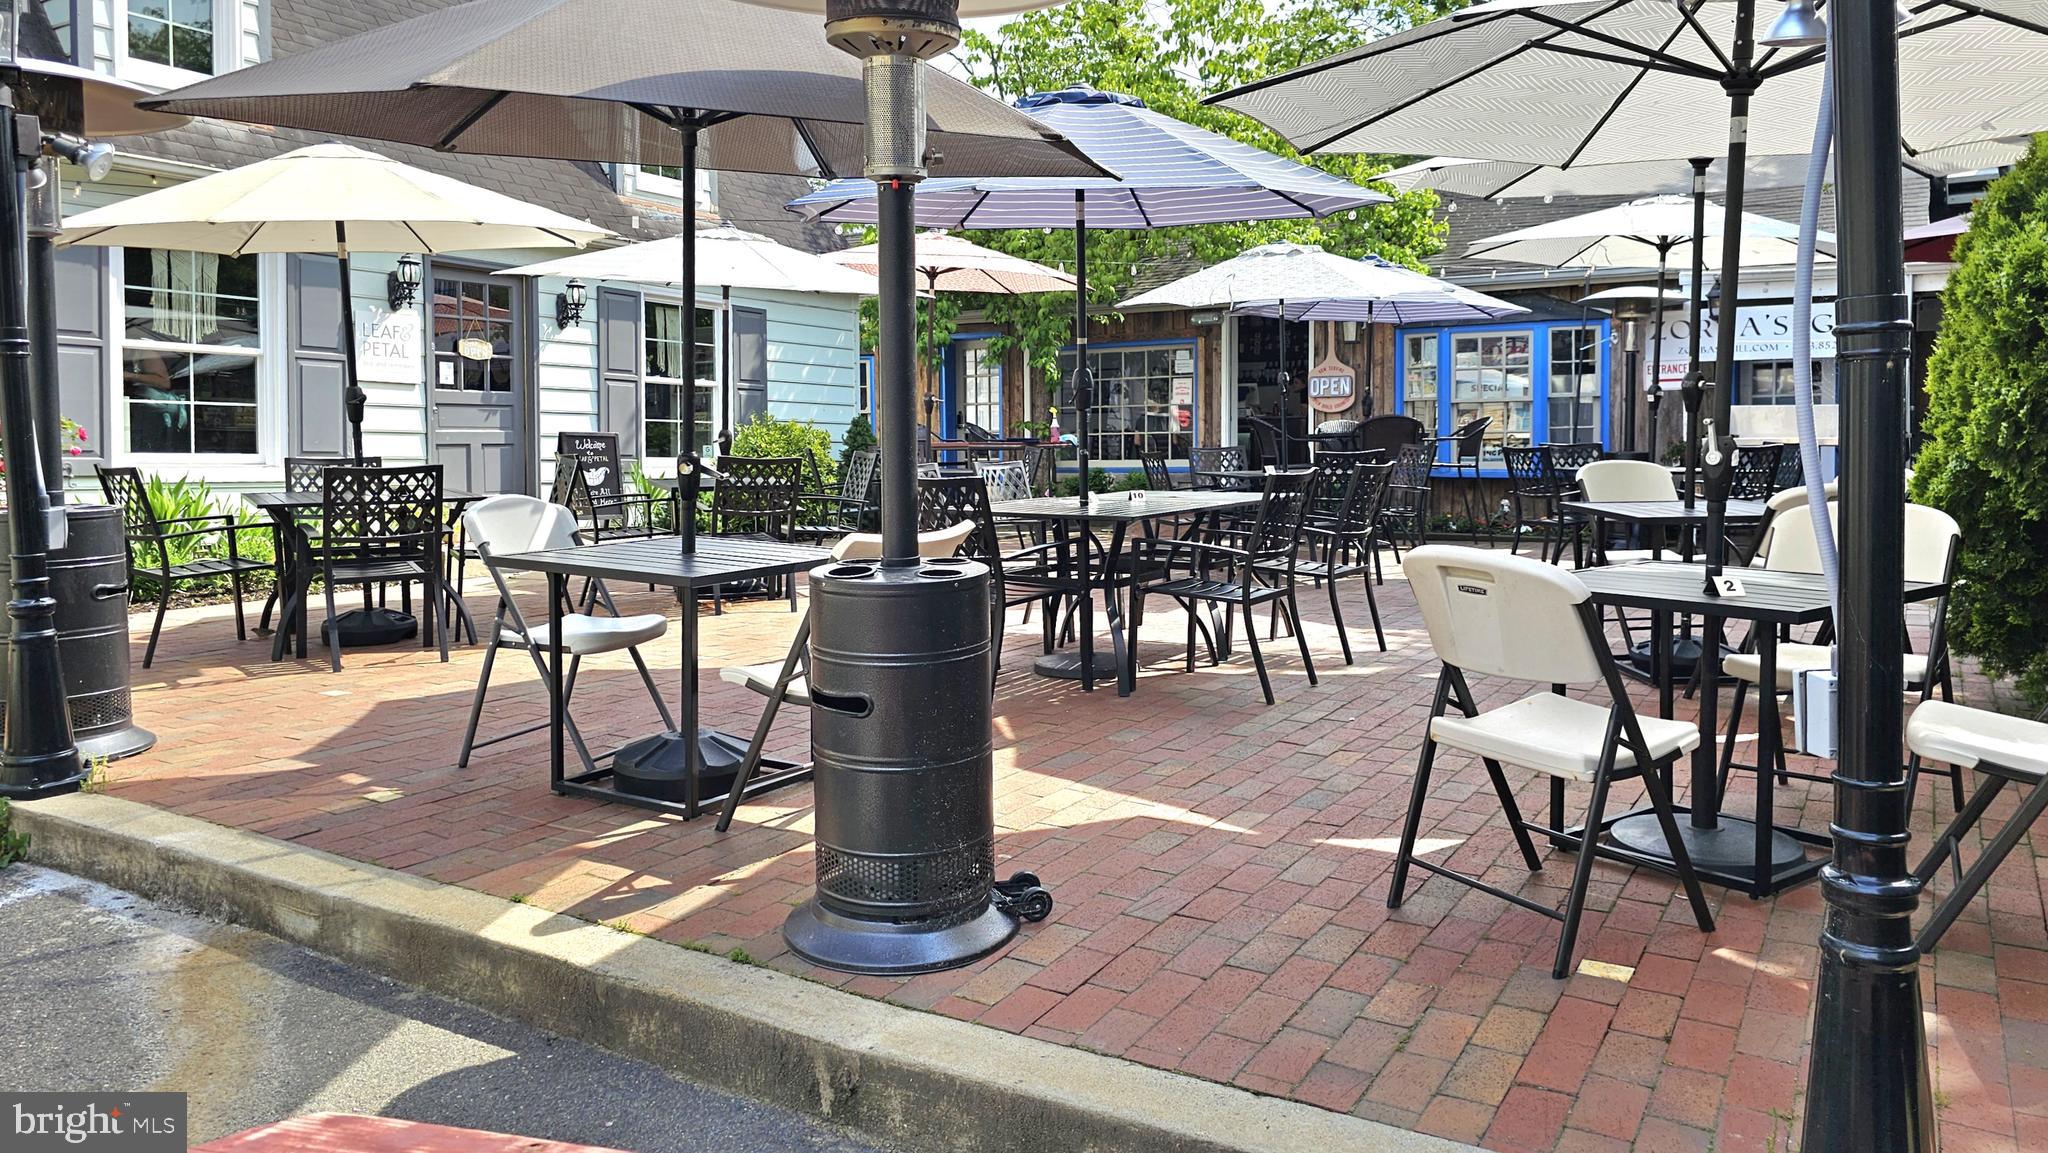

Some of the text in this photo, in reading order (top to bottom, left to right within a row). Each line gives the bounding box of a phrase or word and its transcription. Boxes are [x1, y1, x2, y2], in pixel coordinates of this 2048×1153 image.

[362, 341, 409, 359] PETAL
[1647, 363, 1688, 376] ETRANCE
[1310, 377, 1350, 396] OPEN
[575, 438, 606, 451] Welcome
[1723, 580, 1737, 592] 2
